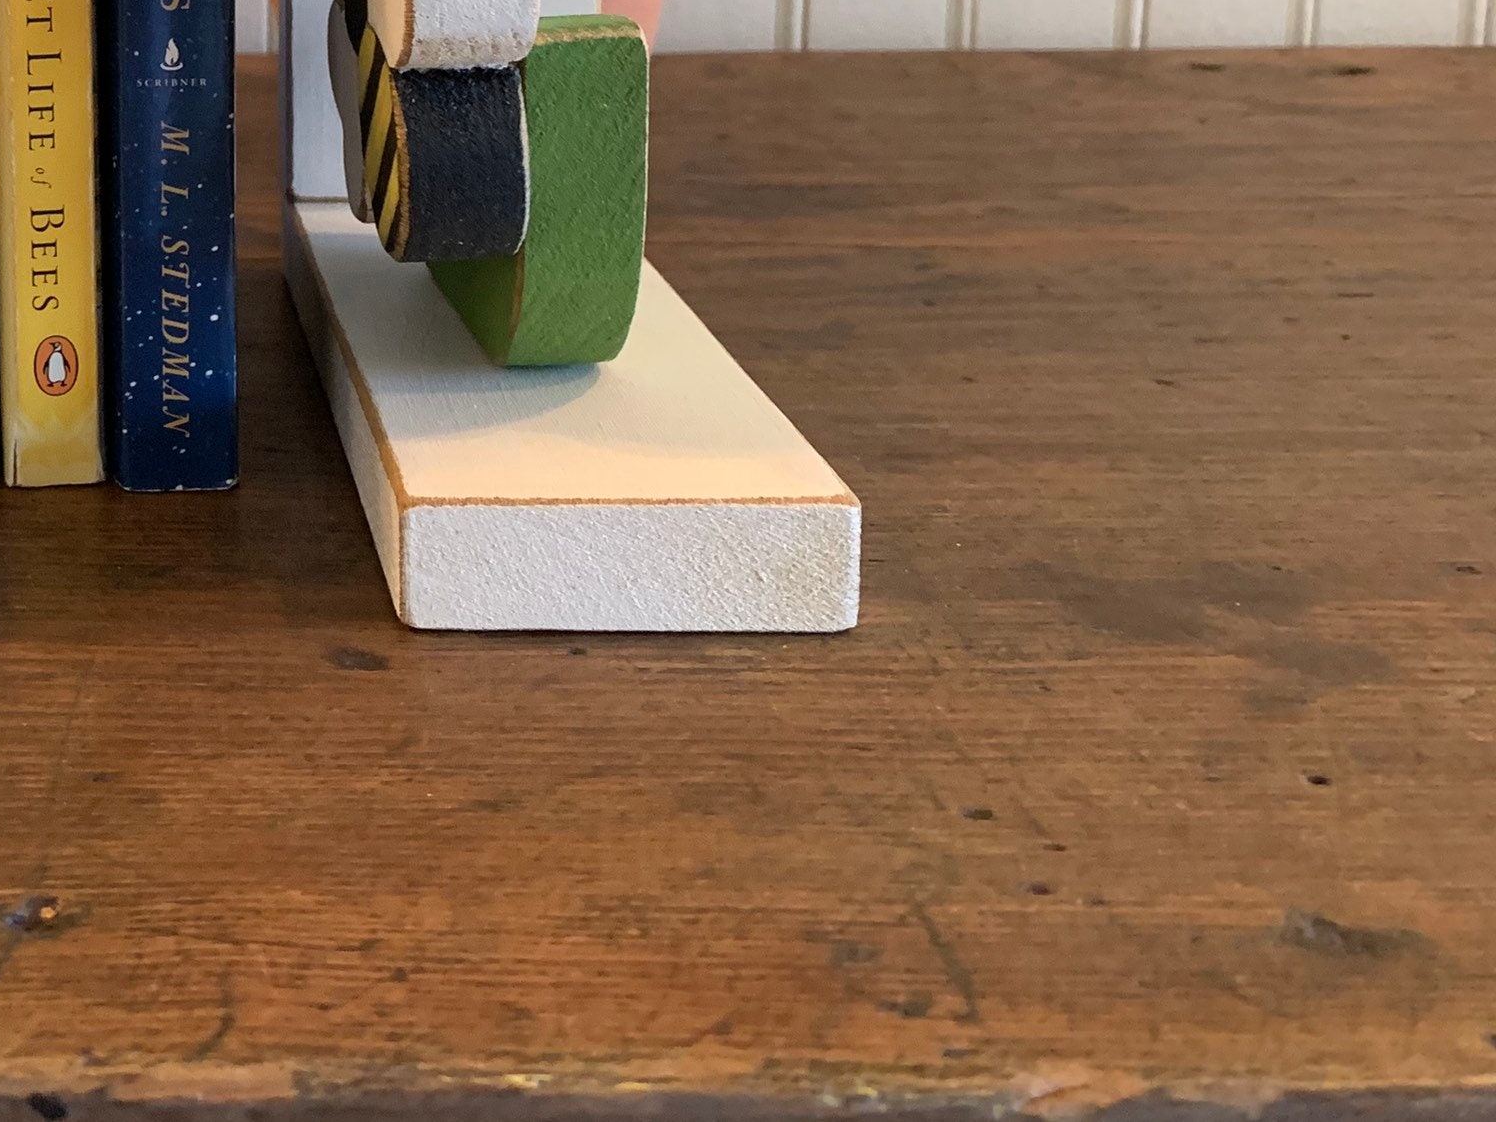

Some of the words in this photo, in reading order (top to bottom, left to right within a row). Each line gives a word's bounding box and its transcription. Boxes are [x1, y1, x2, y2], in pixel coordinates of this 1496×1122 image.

[26, 48, 62, 151] LIFE
[136, 77, 208, 88] SCRIBNER
[160, 120, 190, 165] M.
[33, 165, 52, 190] of
[160, 184, 190, 218] L.
[29, 206, 66, 312] BEES
[160, 232, 196, 438] STEDMAN
